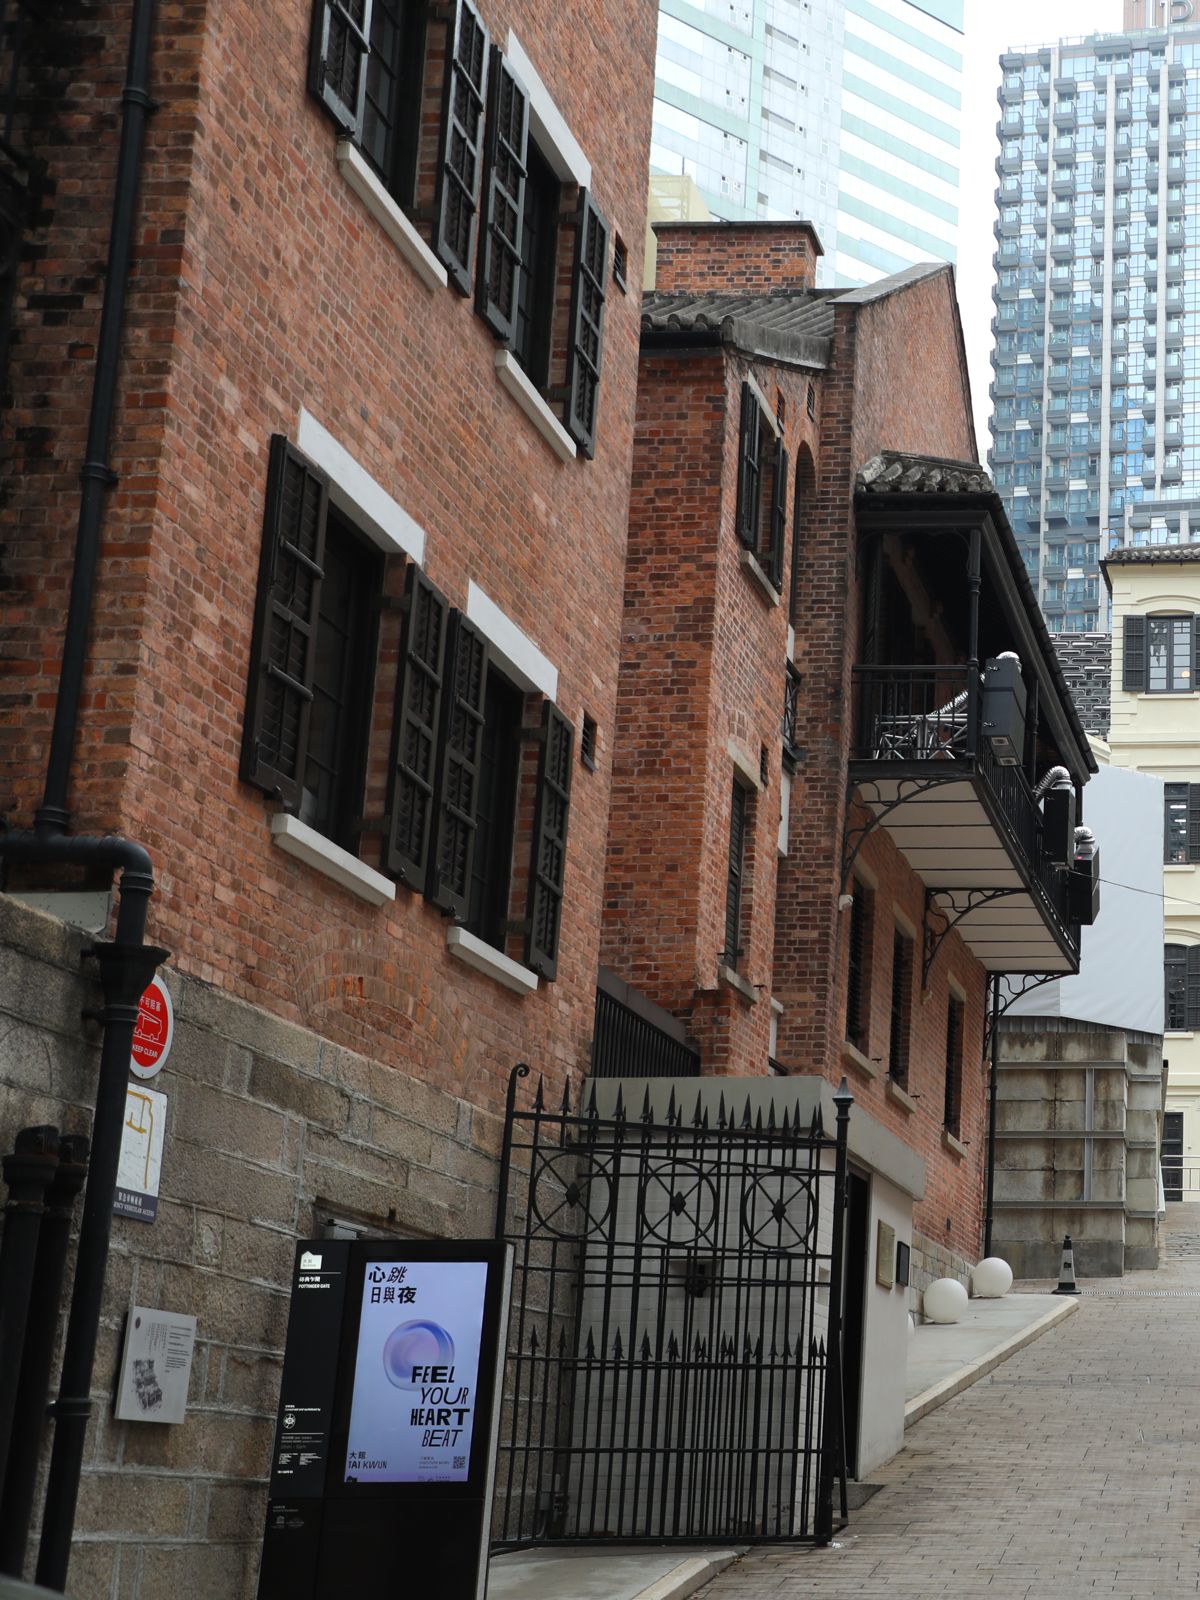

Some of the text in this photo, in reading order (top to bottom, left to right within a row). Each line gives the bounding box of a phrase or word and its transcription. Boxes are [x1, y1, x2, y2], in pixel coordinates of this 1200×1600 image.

[132, 1043, 158, 1058] KEEP CLEAR
[368, 1266, 407, 1283] 心跳
[370, 1287, 417, 1304] 日與夜
[411, 1366, 455, 1383] FEEL
[421, 1387, 469, 1405] YOUR
[410, 1408, 470, 1426] HEART
[421, 1429, 463, 1447] BEAT
[348, 1461, 388, 1469] TAI KWUN
